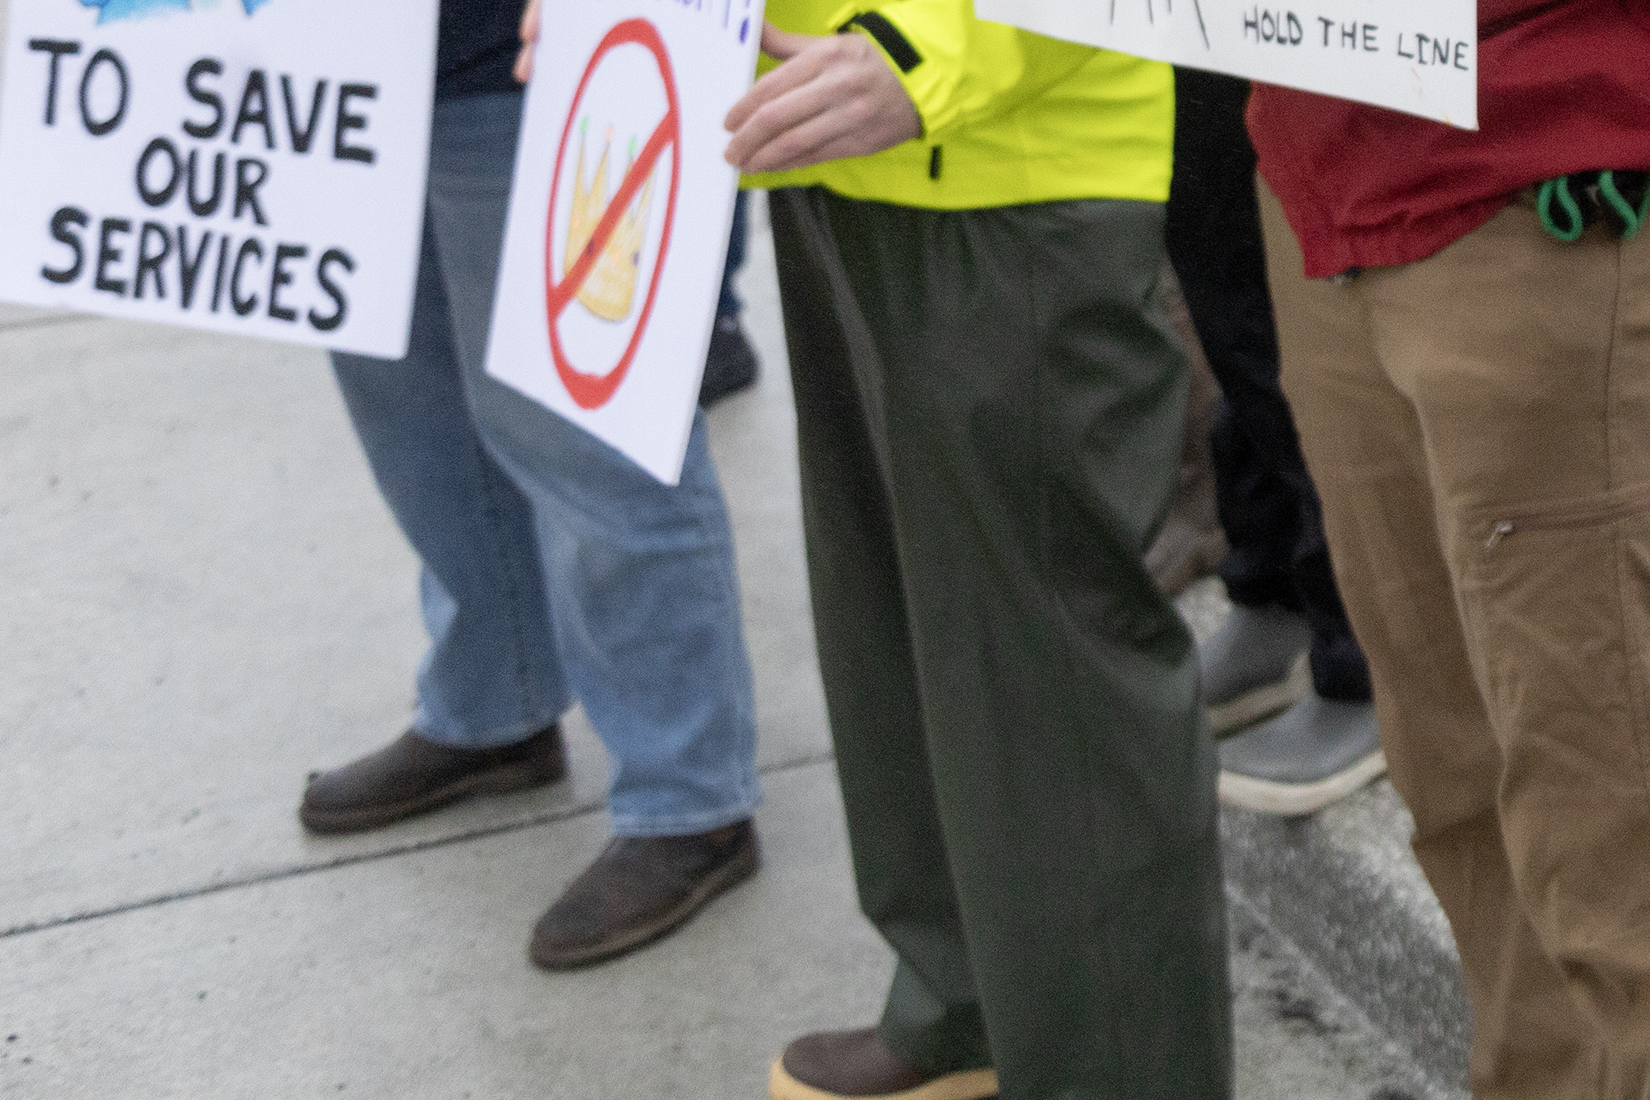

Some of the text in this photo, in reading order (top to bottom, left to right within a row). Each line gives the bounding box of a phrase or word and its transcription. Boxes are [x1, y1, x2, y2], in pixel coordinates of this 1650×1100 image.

[1243, 4, 1470, 72] HOLD THE LINE
[28, 38, 379, 164] TO SAVE
[135, 137, 269, 227] OUR
[40, 206, 356, 332] SERVICES
